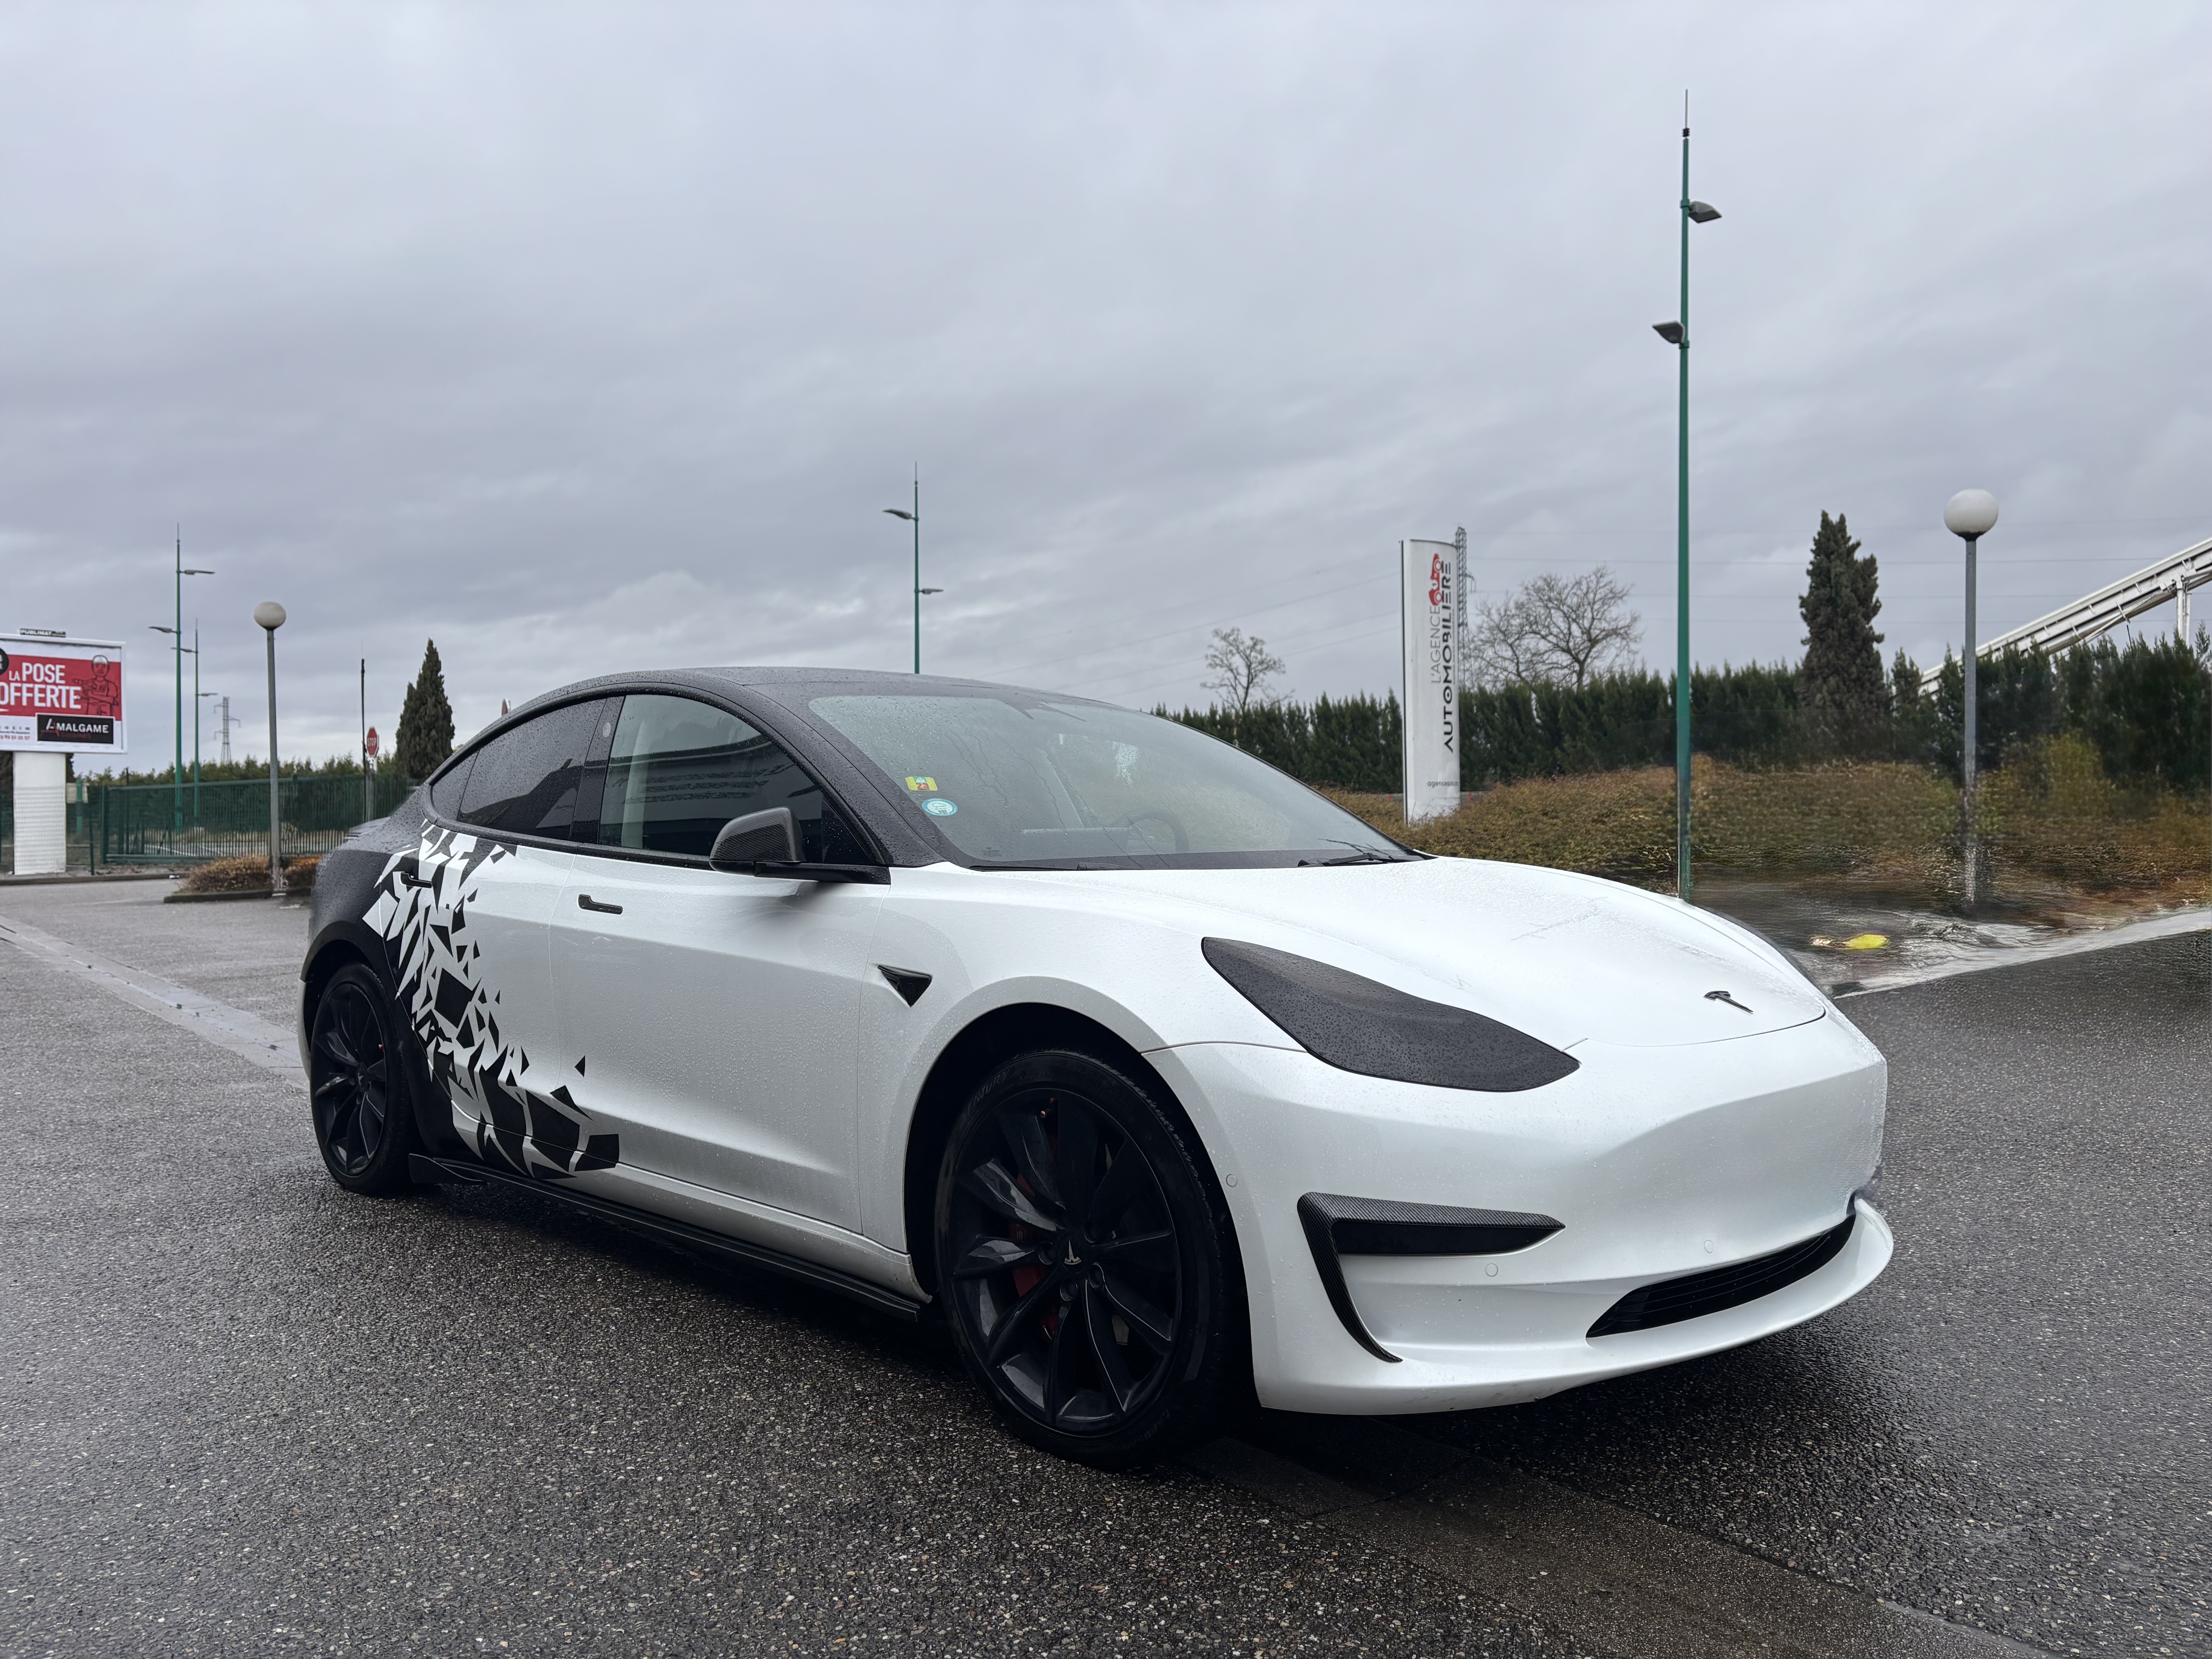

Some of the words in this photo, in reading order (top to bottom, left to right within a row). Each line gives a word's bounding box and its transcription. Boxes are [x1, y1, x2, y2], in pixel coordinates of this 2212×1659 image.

[1431, 605, 1441, 683] L'AGENCE
[9, 670, 20, 681] LA
[22, 662, 65, 684] POSE
[0, 682, 81, 709] OFFERTE
[46, 718, 109, 736] AMALGAME
[368, 737, 376, 746] STOP
